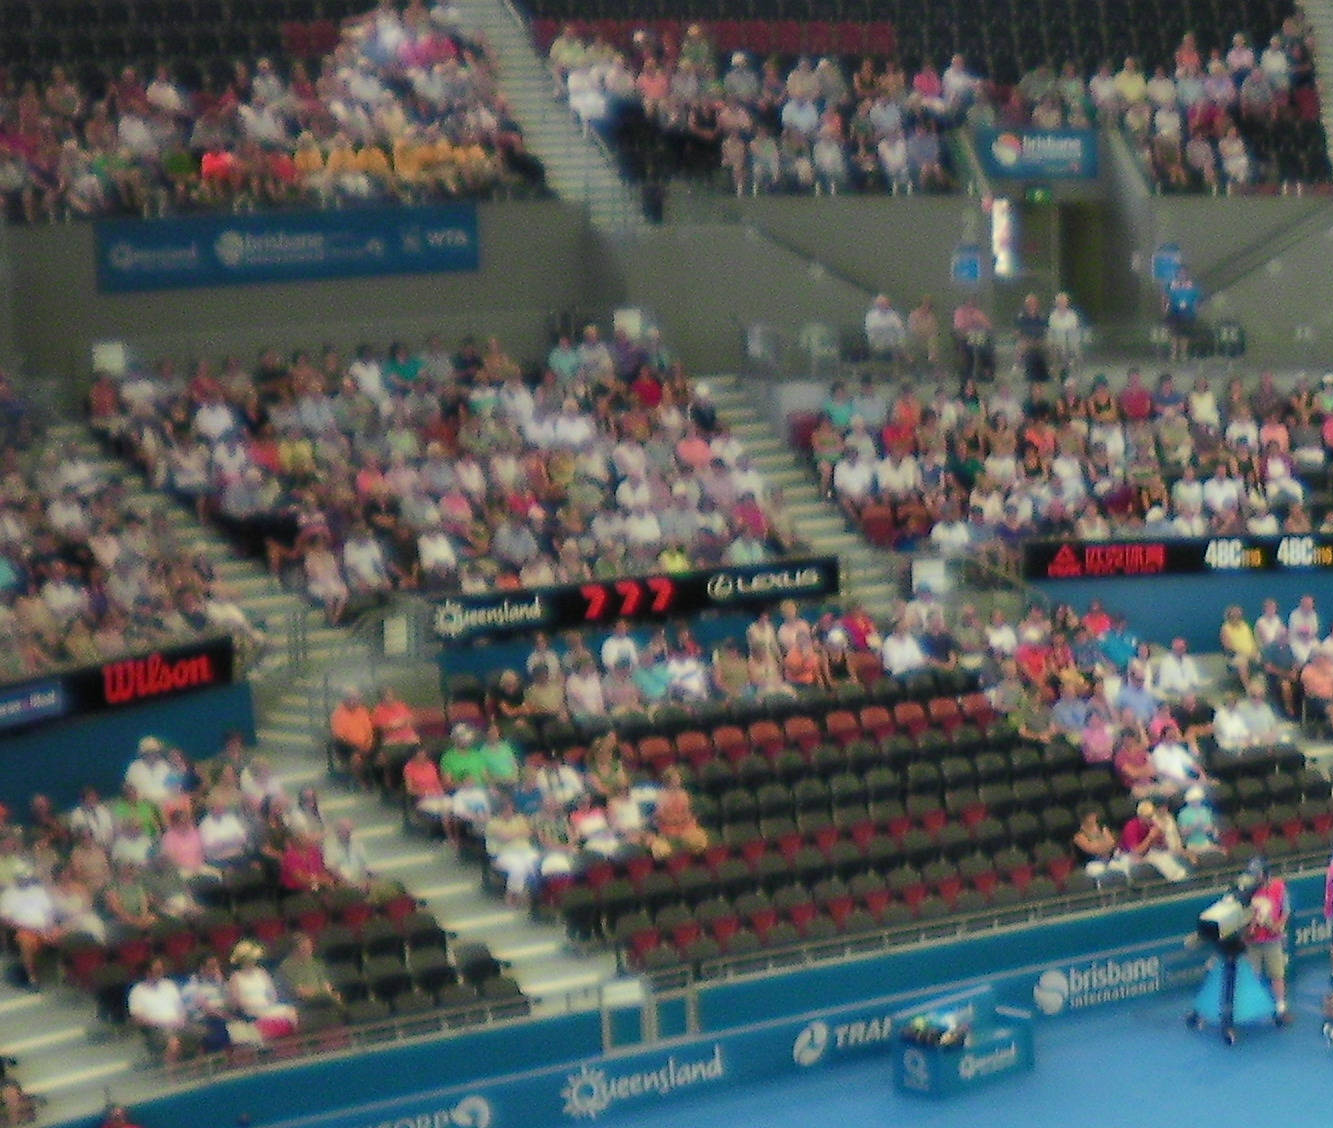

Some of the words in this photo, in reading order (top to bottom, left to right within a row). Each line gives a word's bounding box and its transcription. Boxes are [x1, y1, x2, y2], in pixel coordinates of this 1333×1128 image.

[581, 582, 608, 620] 7
[615, 579, 641, 615] 7
[647, 577, 675, 612] 7
[737, 568, 820, 594] LEXUS
[434, 595, 541, 637] Queensland
[103, 652, 213, 704] Wilson
[1069, 955, 1160, 994] brisbane
[561, 1043, 724, 1119] Queensland
